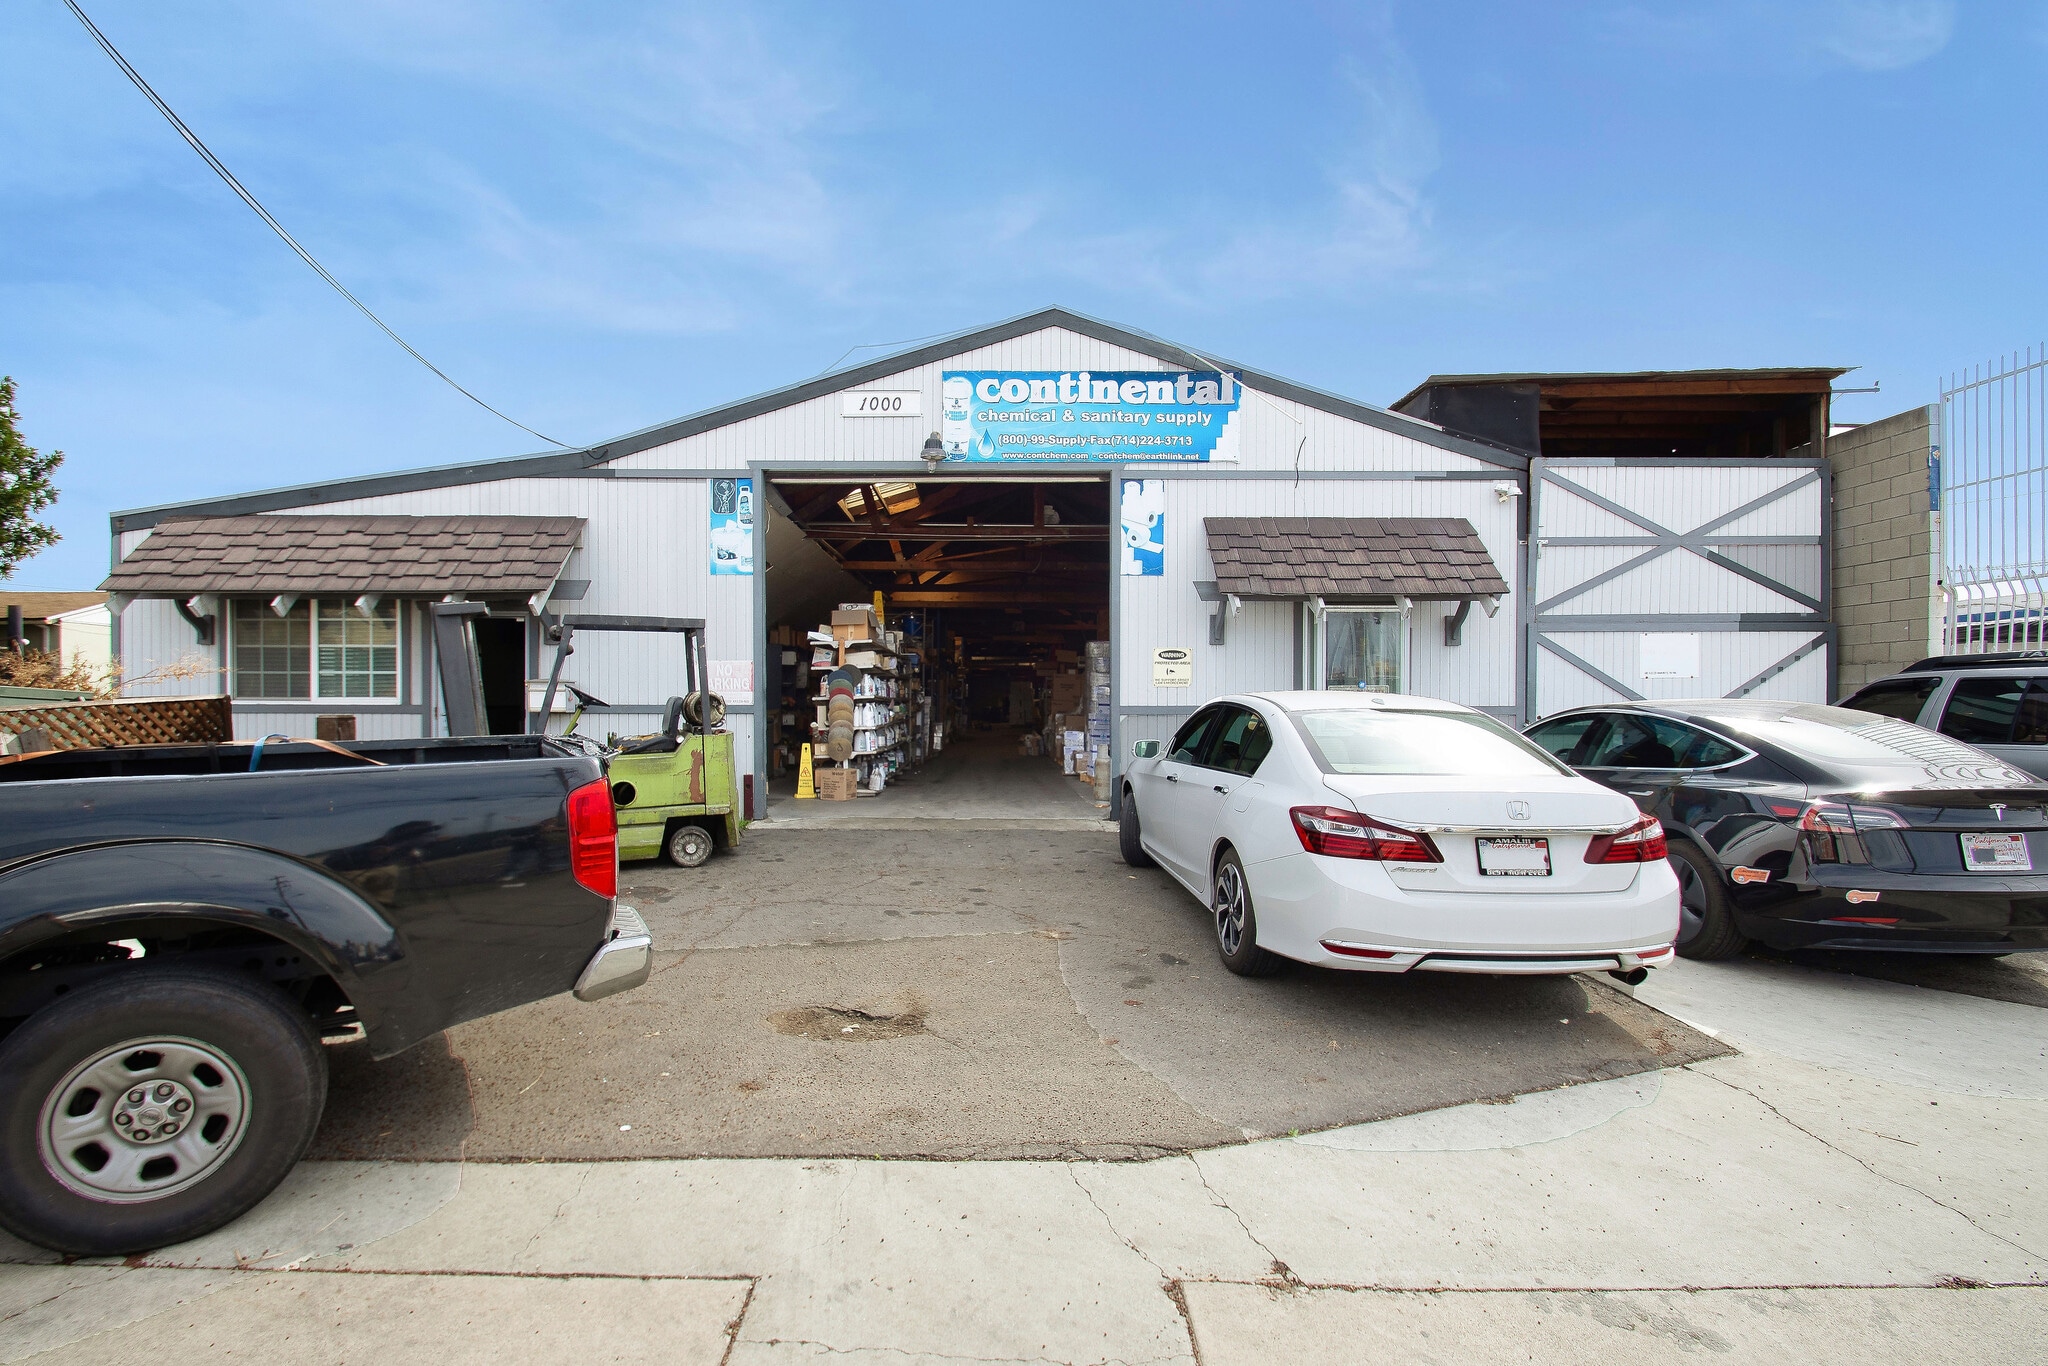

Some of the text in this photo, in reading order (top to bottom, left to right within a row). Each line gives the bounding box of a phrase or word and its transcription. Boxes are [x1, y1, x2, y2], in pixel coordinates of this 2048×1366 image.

[975, 372, 1236, 405] continental
[859, 396, 902, 411] 1000
[977, 409, 1057, 424] chemical
[1062, 410, 1076, 423] &
[1081, 410, 1151, 426] sanitary
[1156, 411, 1213, 426] supply
[1002, 452, 1089, 460] www.contchem.com
[1098, 452, 1200, 461] contchem@earthlink.net
[716, 664, 733, 677] NO
[708, 677, 749, 690] ARKING
[1975, 836, 2008, 845] California
[1390, 866, 1438, 874] Accord
